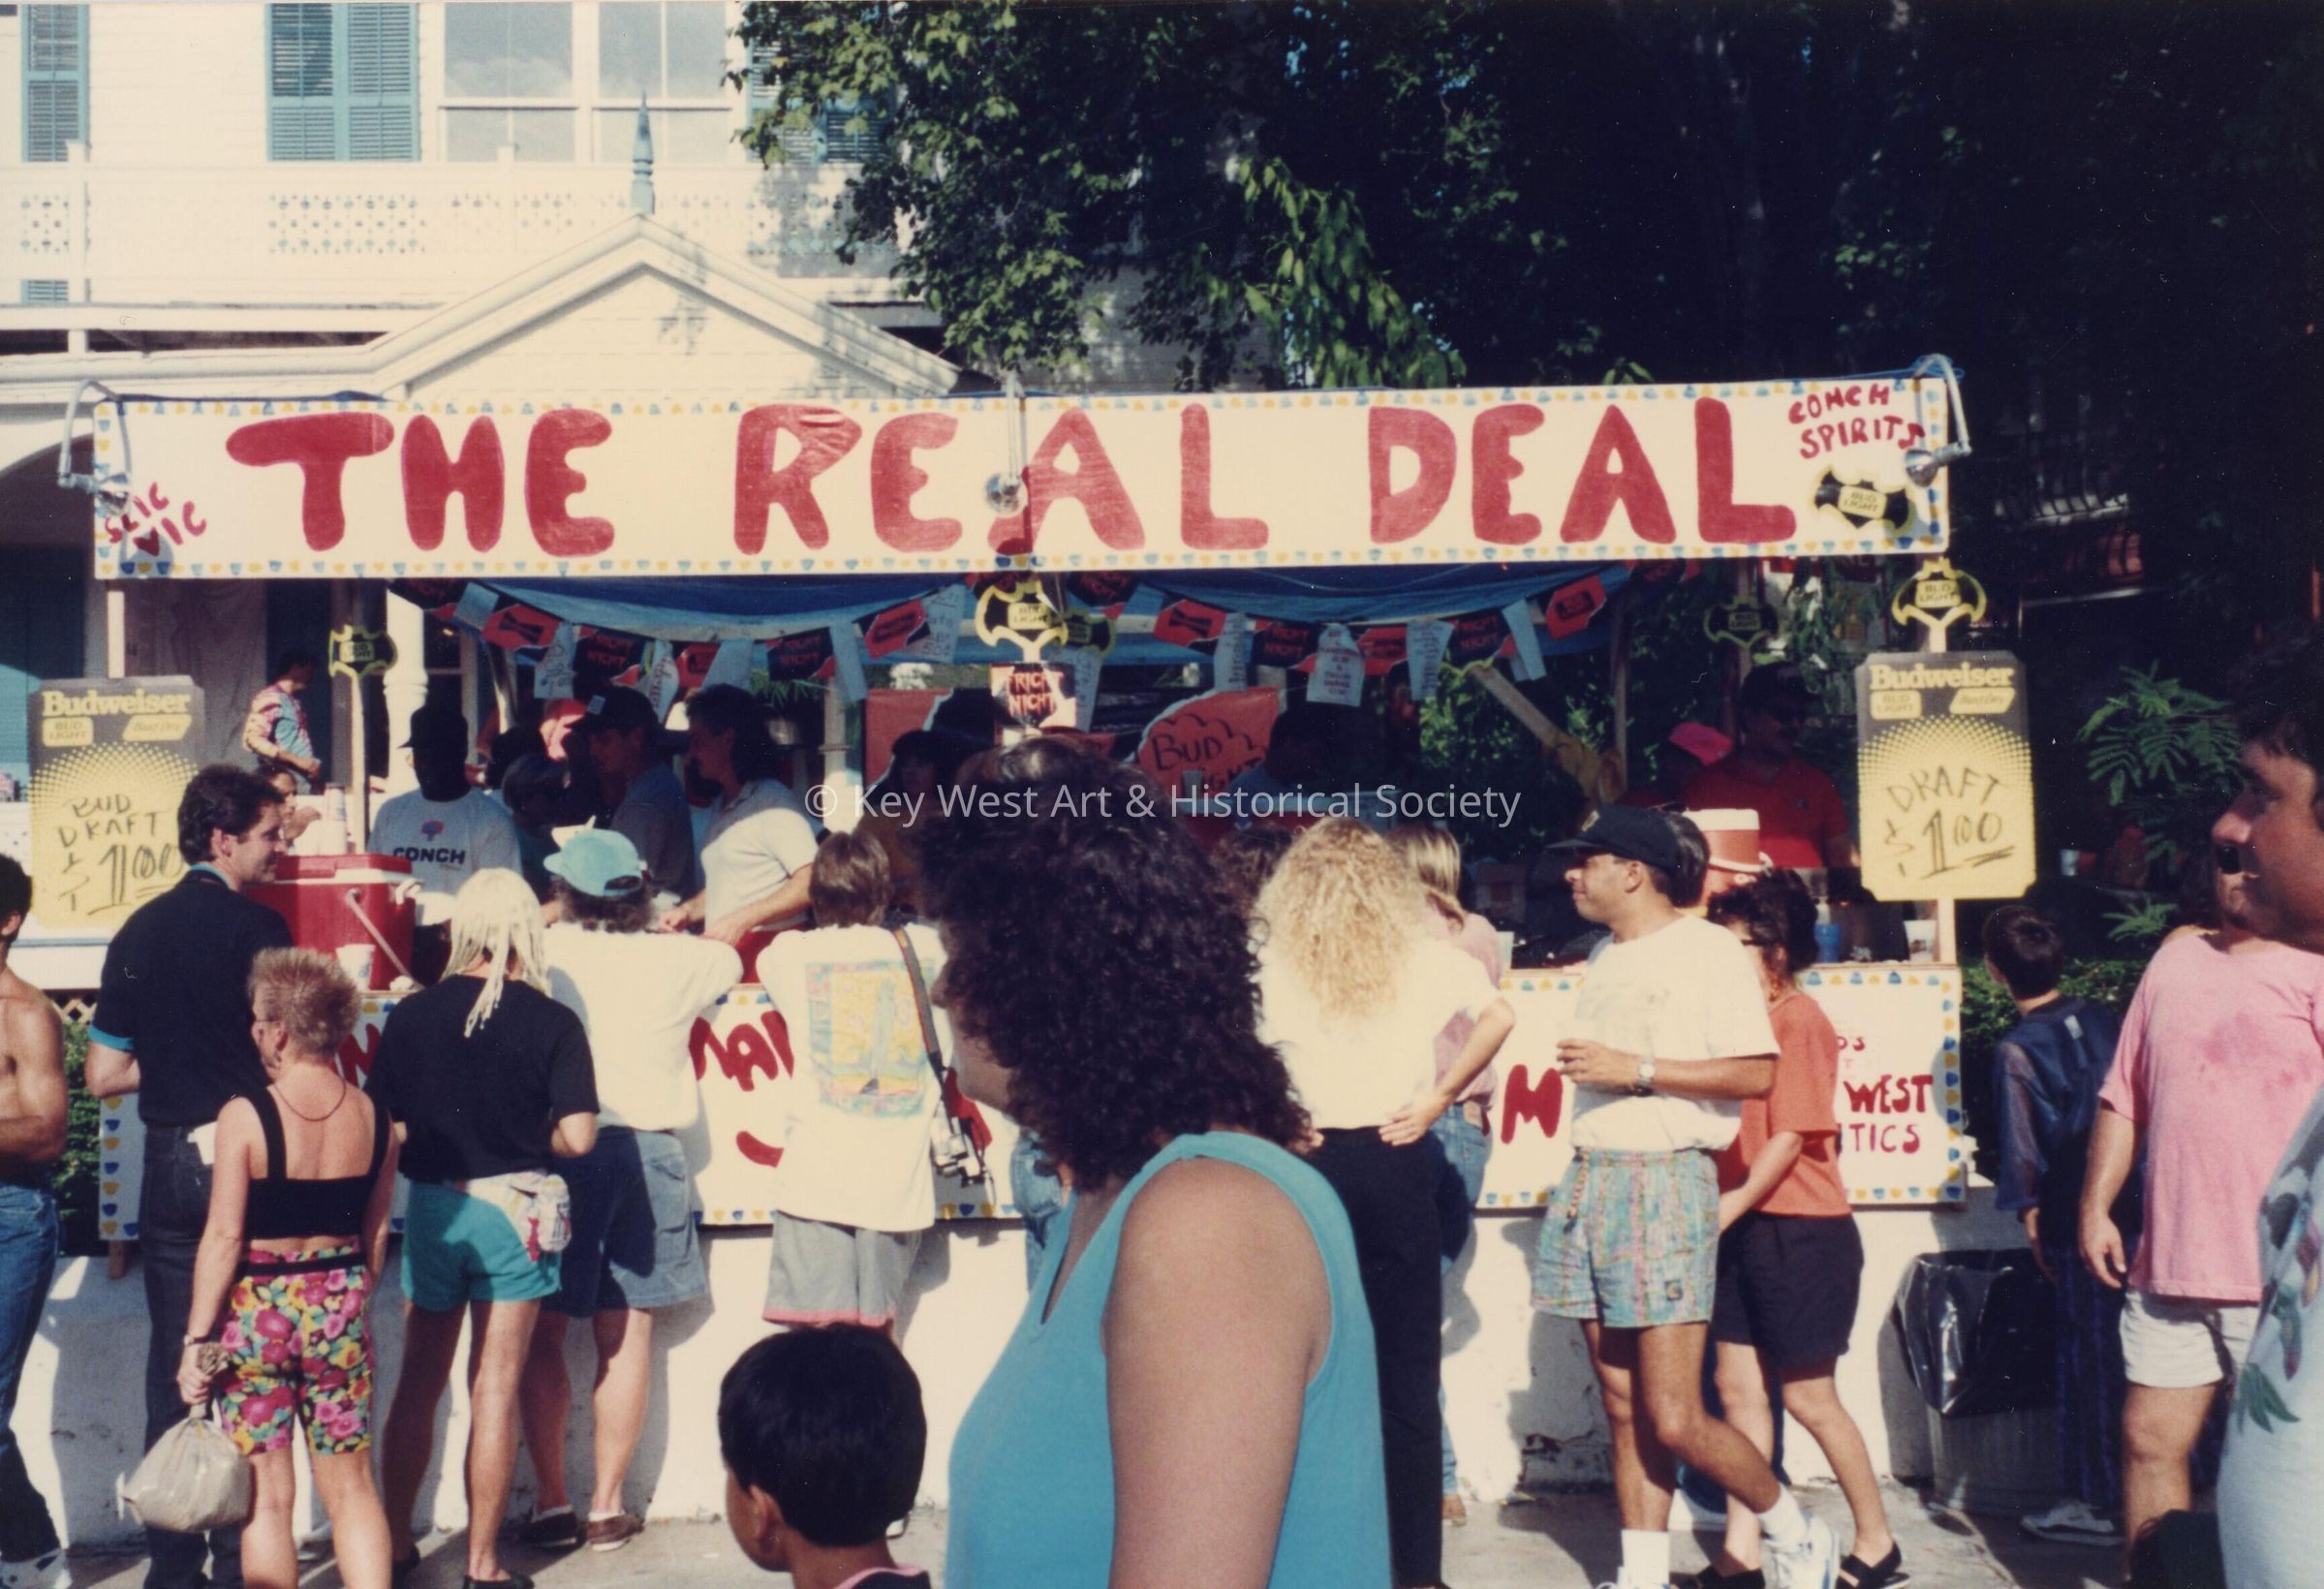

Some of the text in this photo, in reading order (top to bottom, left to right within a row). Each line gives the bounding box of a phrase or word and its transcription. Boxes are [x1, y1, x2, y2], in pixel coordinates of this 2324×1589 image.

[1789, 383, 1889, 423] CONCH
[1800, 415, 1925, 459] SPIRITS
[226, 397, 1797, 557] THE REAL DEAL
[1869, 661, 2015, 691] Budweiser
[42, 688, 191, 717] Budweiser
[1152, 733, 1223, 771] BUD
[68, 794, 131, 818] BUD
[1886, 764, 2010, 813] DRAFT
[58, 808, 171, 848] DRAFT
[393, 848, 467, 865] CONCH
[1843, 1075, 1934, 1114] WEST
